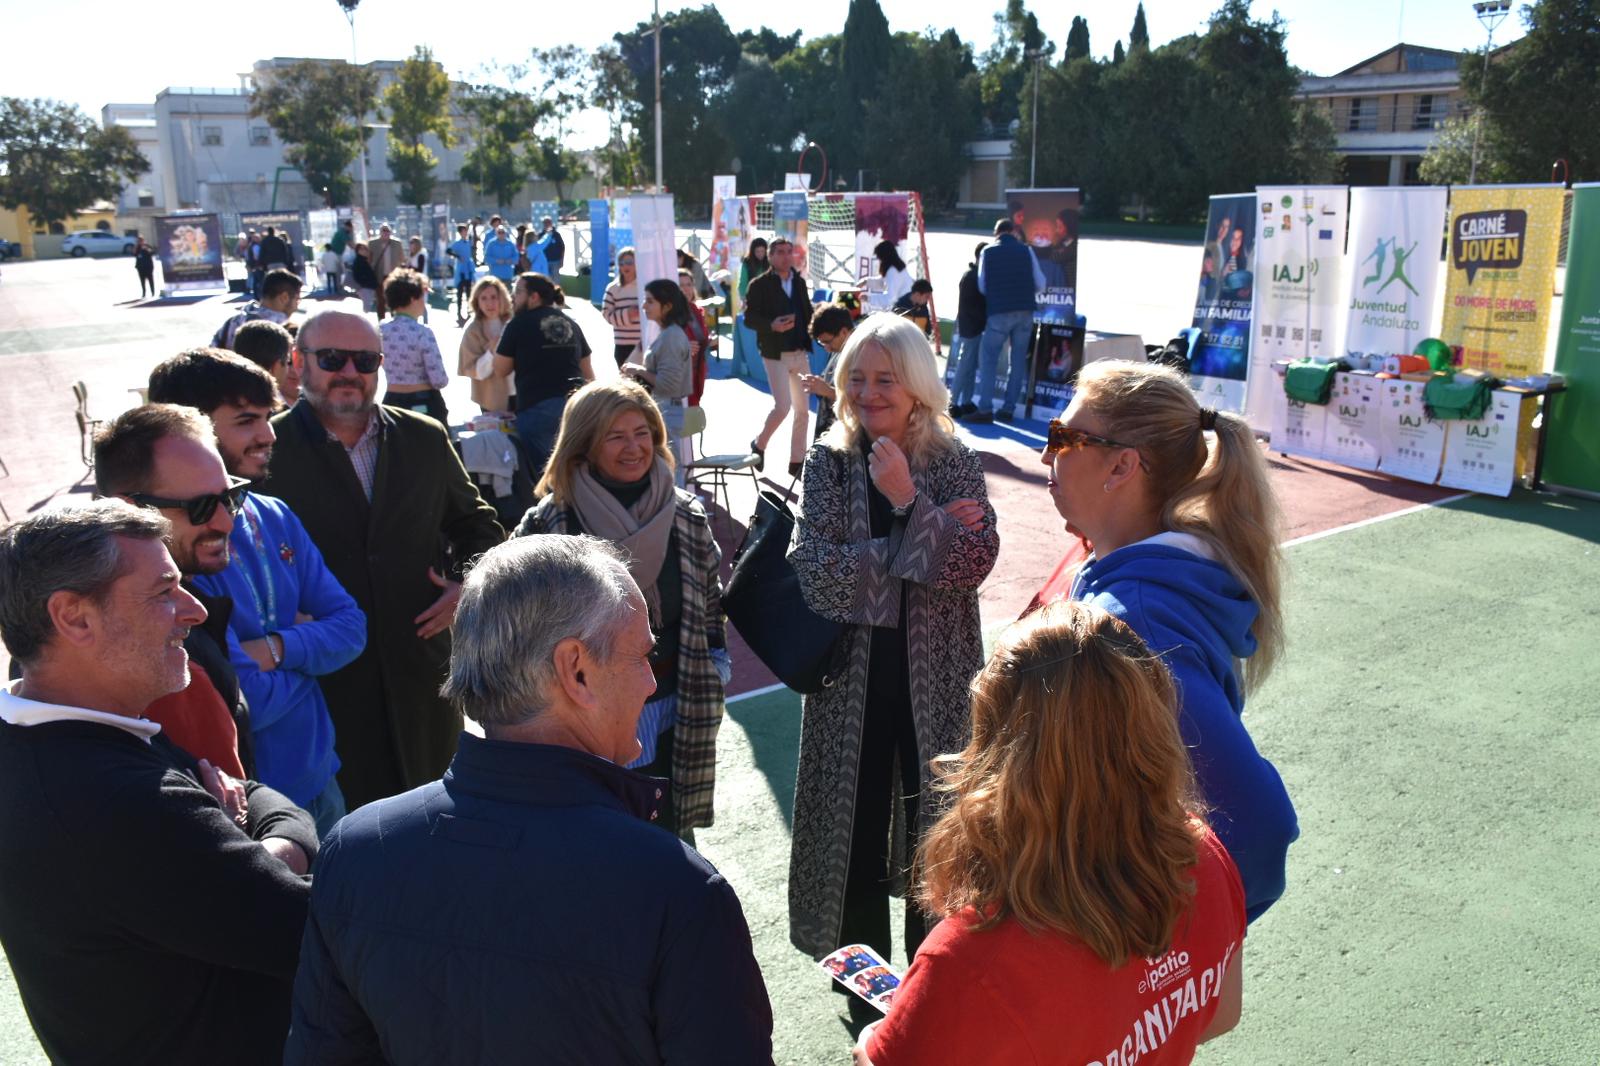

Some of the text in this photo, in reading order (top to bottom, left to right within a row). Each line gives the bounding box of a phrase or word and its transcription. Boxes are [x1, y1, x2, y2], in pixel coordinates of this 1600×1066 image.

[1460, 214, 1507, 236] CARNÉ
[1459, 238, 1519, 262] JOVEN
[1272, 264, 1305, 283] IAJ
[1350, 298, 1408, 313] Juventud
[1362, 313, 1420, 330] Andaluza
[1339, 405, 1359, 418] IAJ
[1399, 414, 1422, 428] IAJ
[1466, 424, 1490, 438] IAJ
